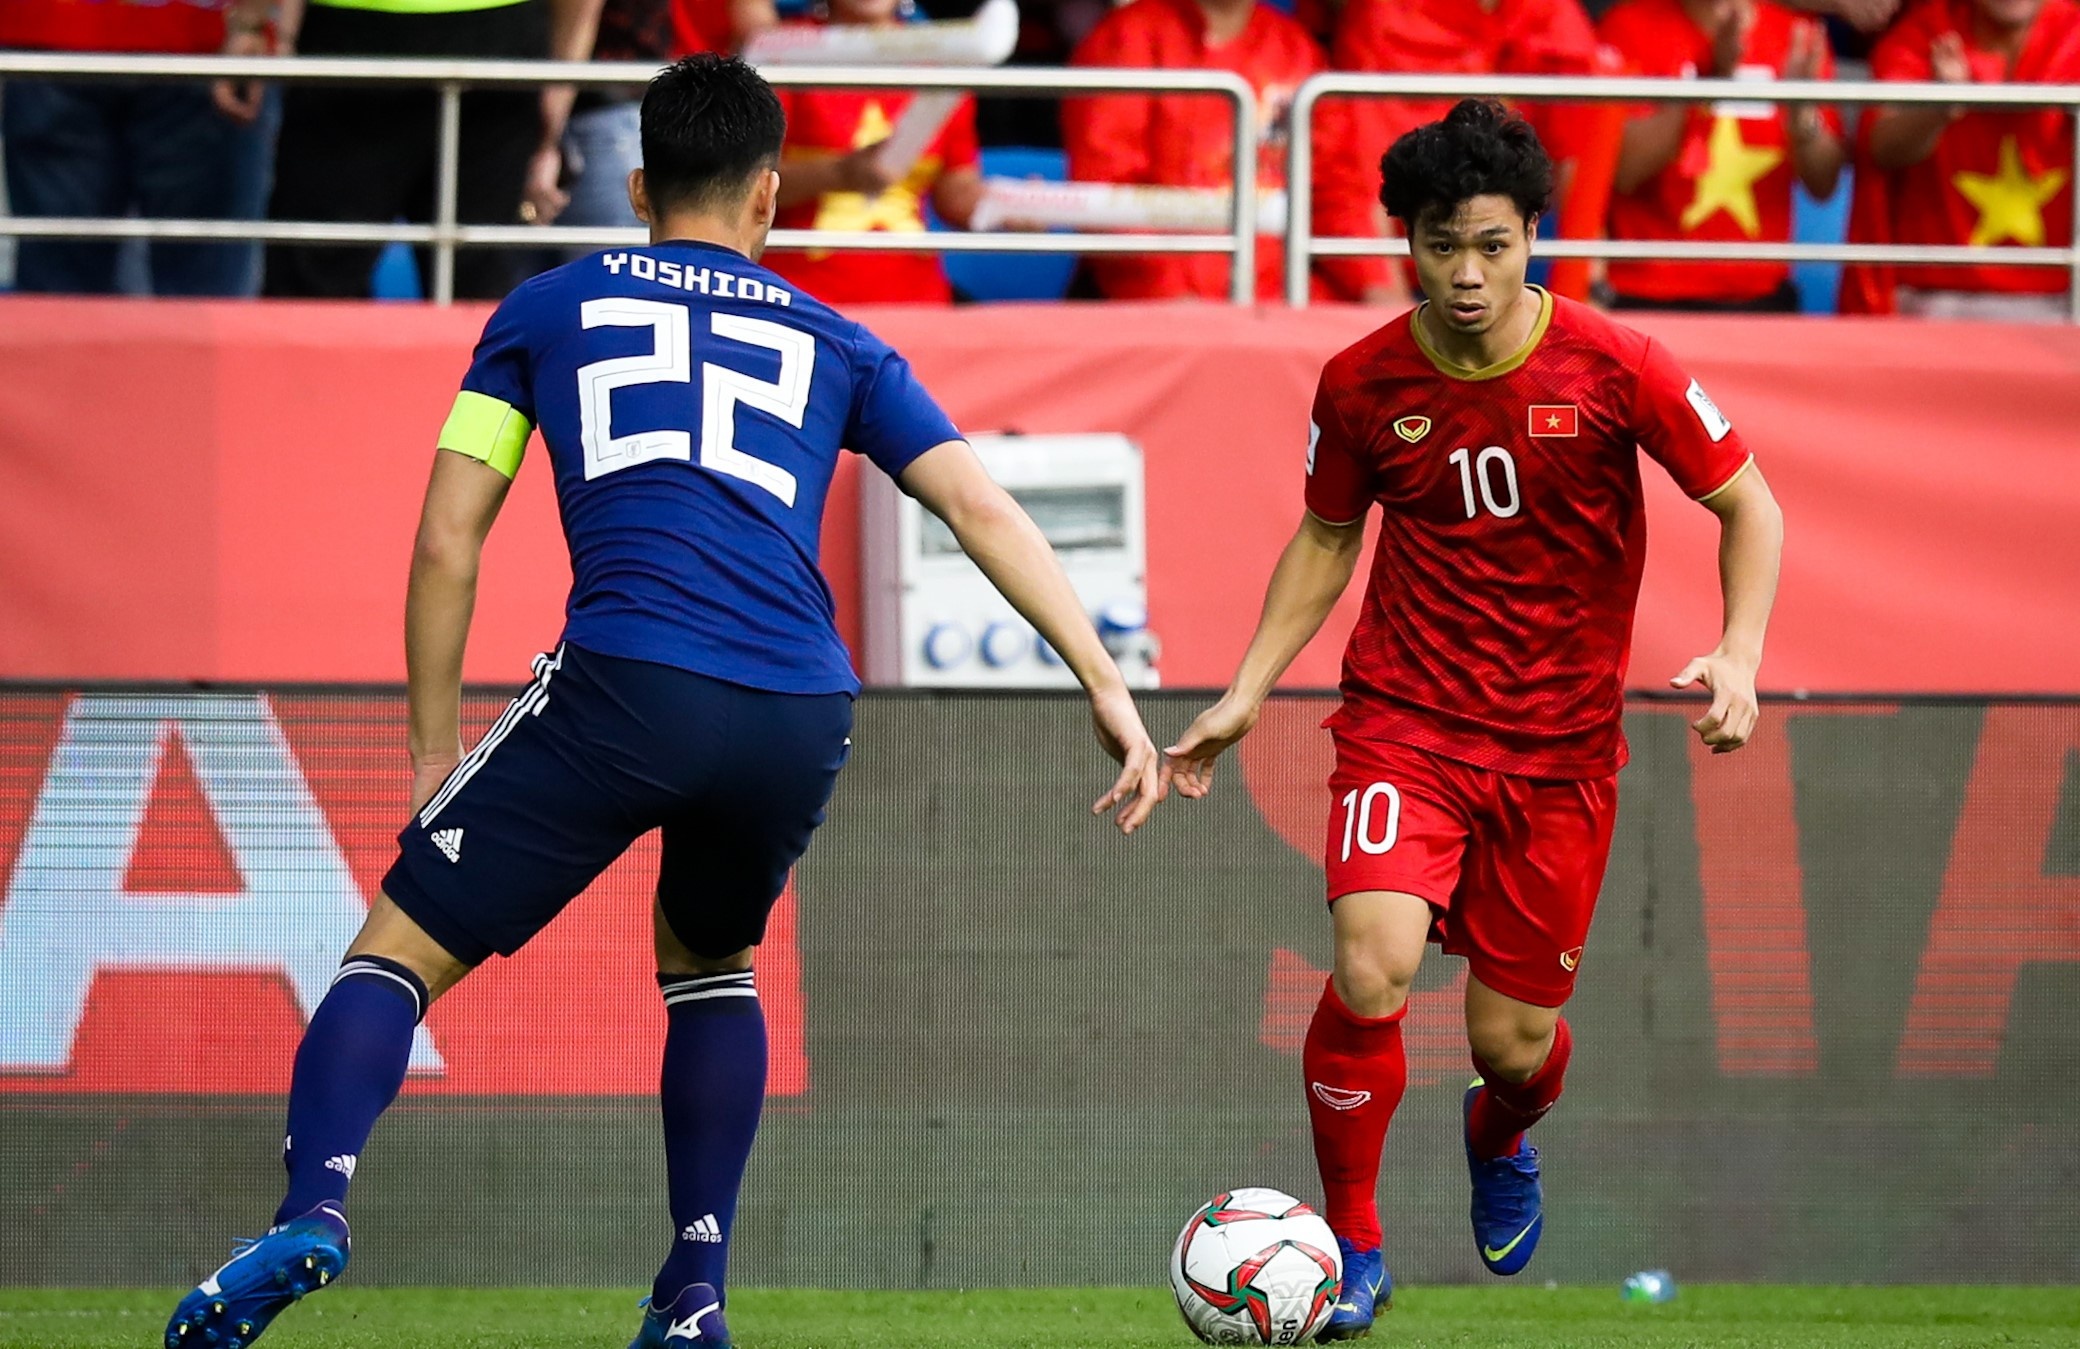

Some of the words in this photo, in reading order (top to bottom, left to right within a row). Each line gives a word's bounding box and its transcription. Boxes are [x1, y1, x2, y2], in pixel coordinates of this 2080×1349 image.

[602, 253, 792, 307] YOSHIDA
[577, 297, 816, 509] 22
[1448, 445, 1520, 519] 10
[430, 831, 461, 864] adidas
[1340, 781, 1401, 863] 10
[681, 1231, 723, 1244] adidas
